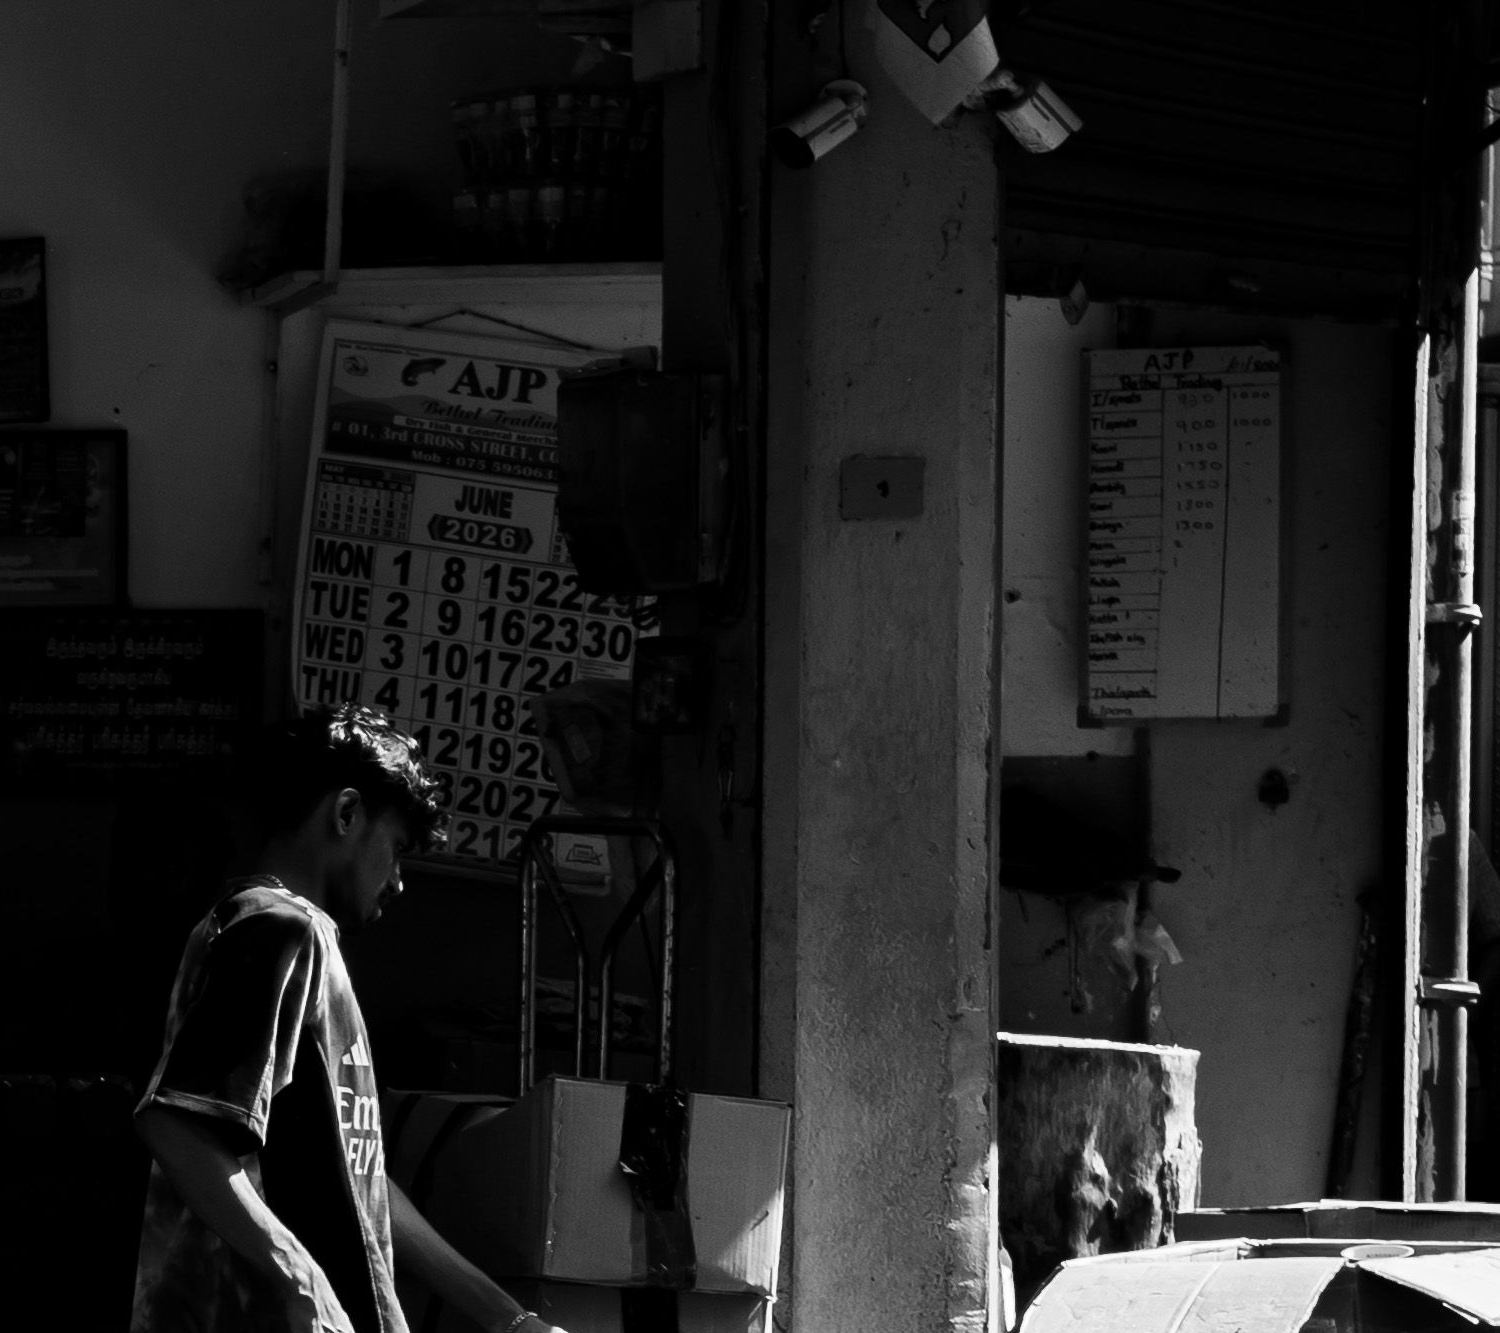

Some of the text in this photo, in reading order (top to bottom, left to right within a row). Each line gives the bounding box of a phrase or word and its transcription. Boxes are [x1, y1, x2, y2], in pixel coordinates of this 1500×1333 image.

[448, 361, 547, 404] AJP
[421, 400, 482, 421] Bethel
[381, 427, 409, 443] 3rd
[413, 430, 468, 452] CROSS
[454, 485, 514, 519] JUNE
[442, 519, 517, 549] 2026
[312, 538, 374, 580] MON
[393, 550, 411, 586] 1
[442, 557, 465, 594] 8
[483, 564, 530, 603] 15
[534, 571, 583, 612] 22
[311, 581, 632, 662] TUE 2 9 16 23 30
[305, 623, 573, 693] WED 3 10 17 24
[303, 665, 361, 704] THU
[375, 677, 400, 714] 4
[420, 682, 462, 723] 11
[470, 691, 514, 732] 18
[466, 733, 511, 774] 19
[457, 777, 506, 817] 20
[509, 785, 559, 822] 27
[456, 820, 501, 861] 21
[348, 1137, 377, 1176] FLY
